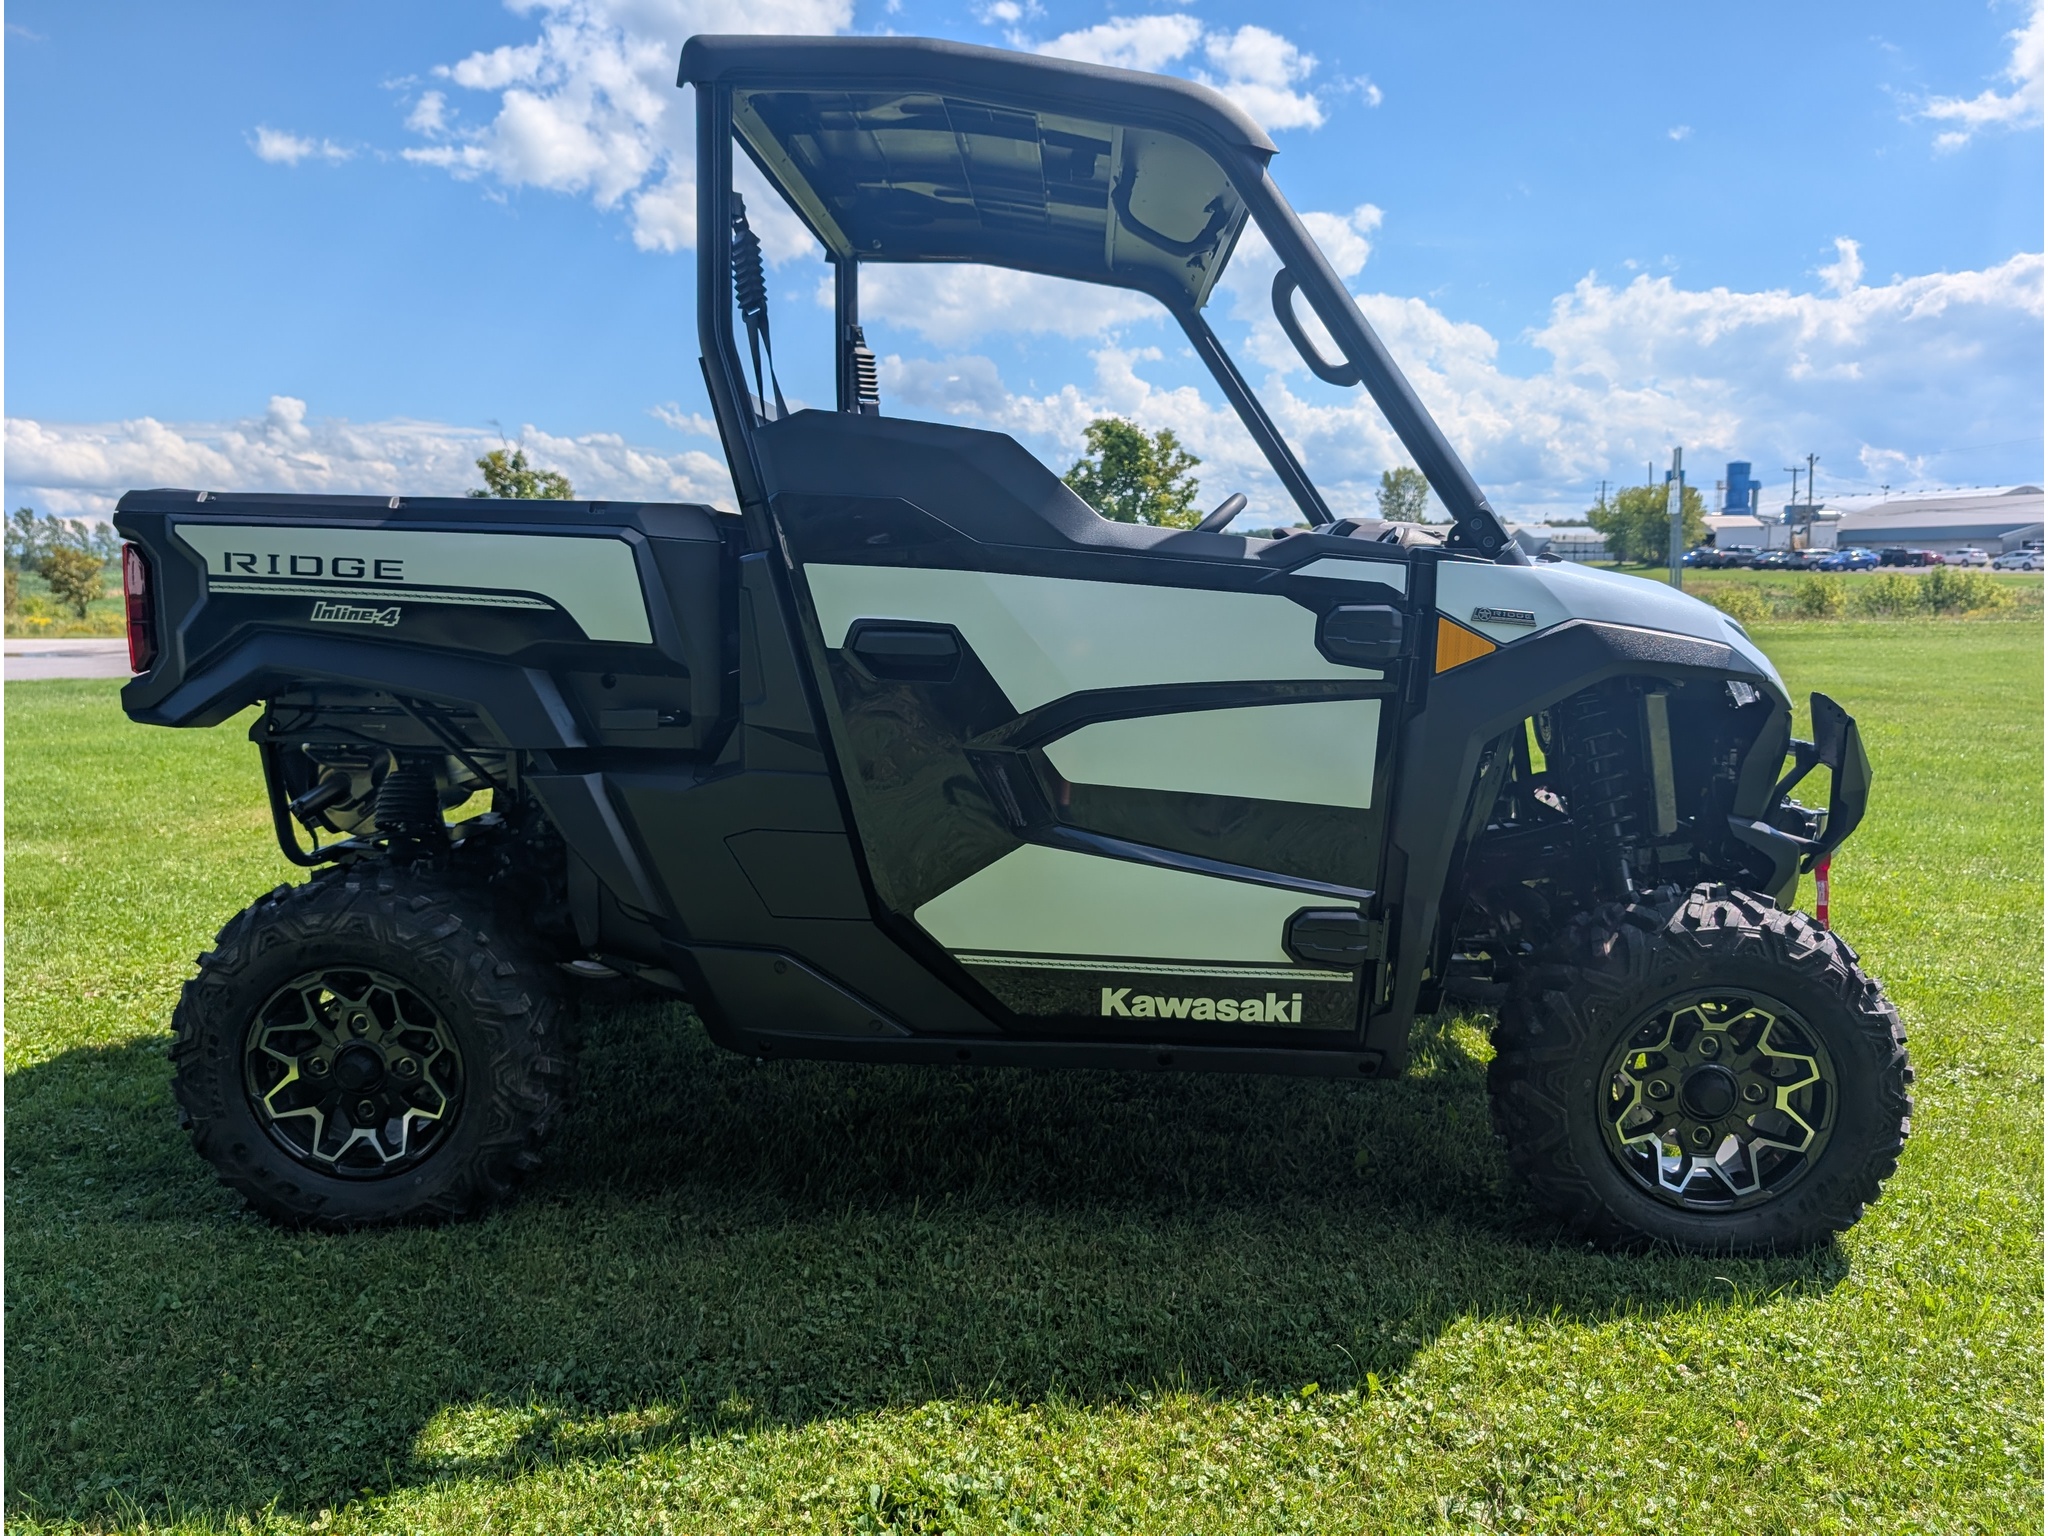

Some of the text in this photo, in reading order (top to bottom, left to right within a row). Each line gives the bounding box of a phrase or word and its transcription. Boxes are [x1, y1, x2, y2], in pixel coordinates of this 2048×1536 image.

[224, 552, 404, 580] RIDGE
[310, 601, 401, 627] Inline-4
[1493, 611, 1532, 620] RIDGE
[1101, 987, 1303, 1023] Kawasaki
